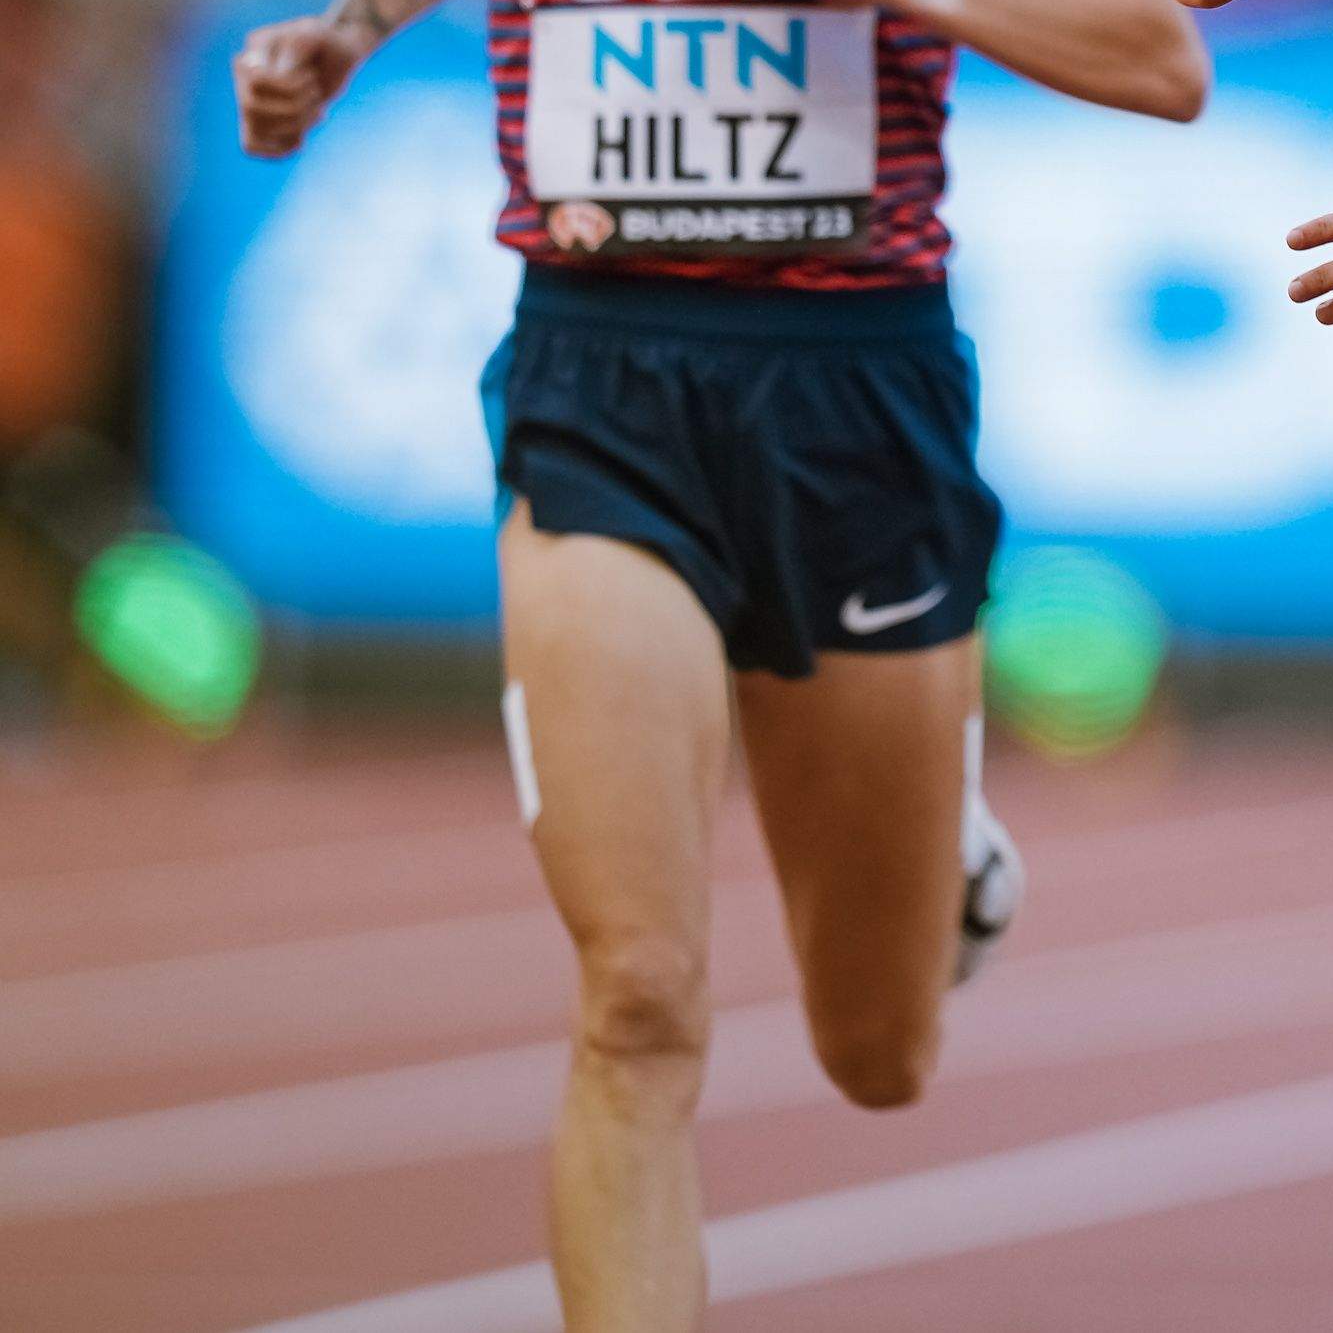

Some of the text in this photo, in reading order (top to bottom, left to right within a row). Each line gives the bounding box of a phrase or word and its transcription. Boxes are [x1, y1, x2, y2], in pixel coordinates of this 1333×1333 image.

[592, 19, 807, 92] NTN
[592, 114, 806, 183] HILTZ
[620, 208, 807, 242] BUDAPEST
